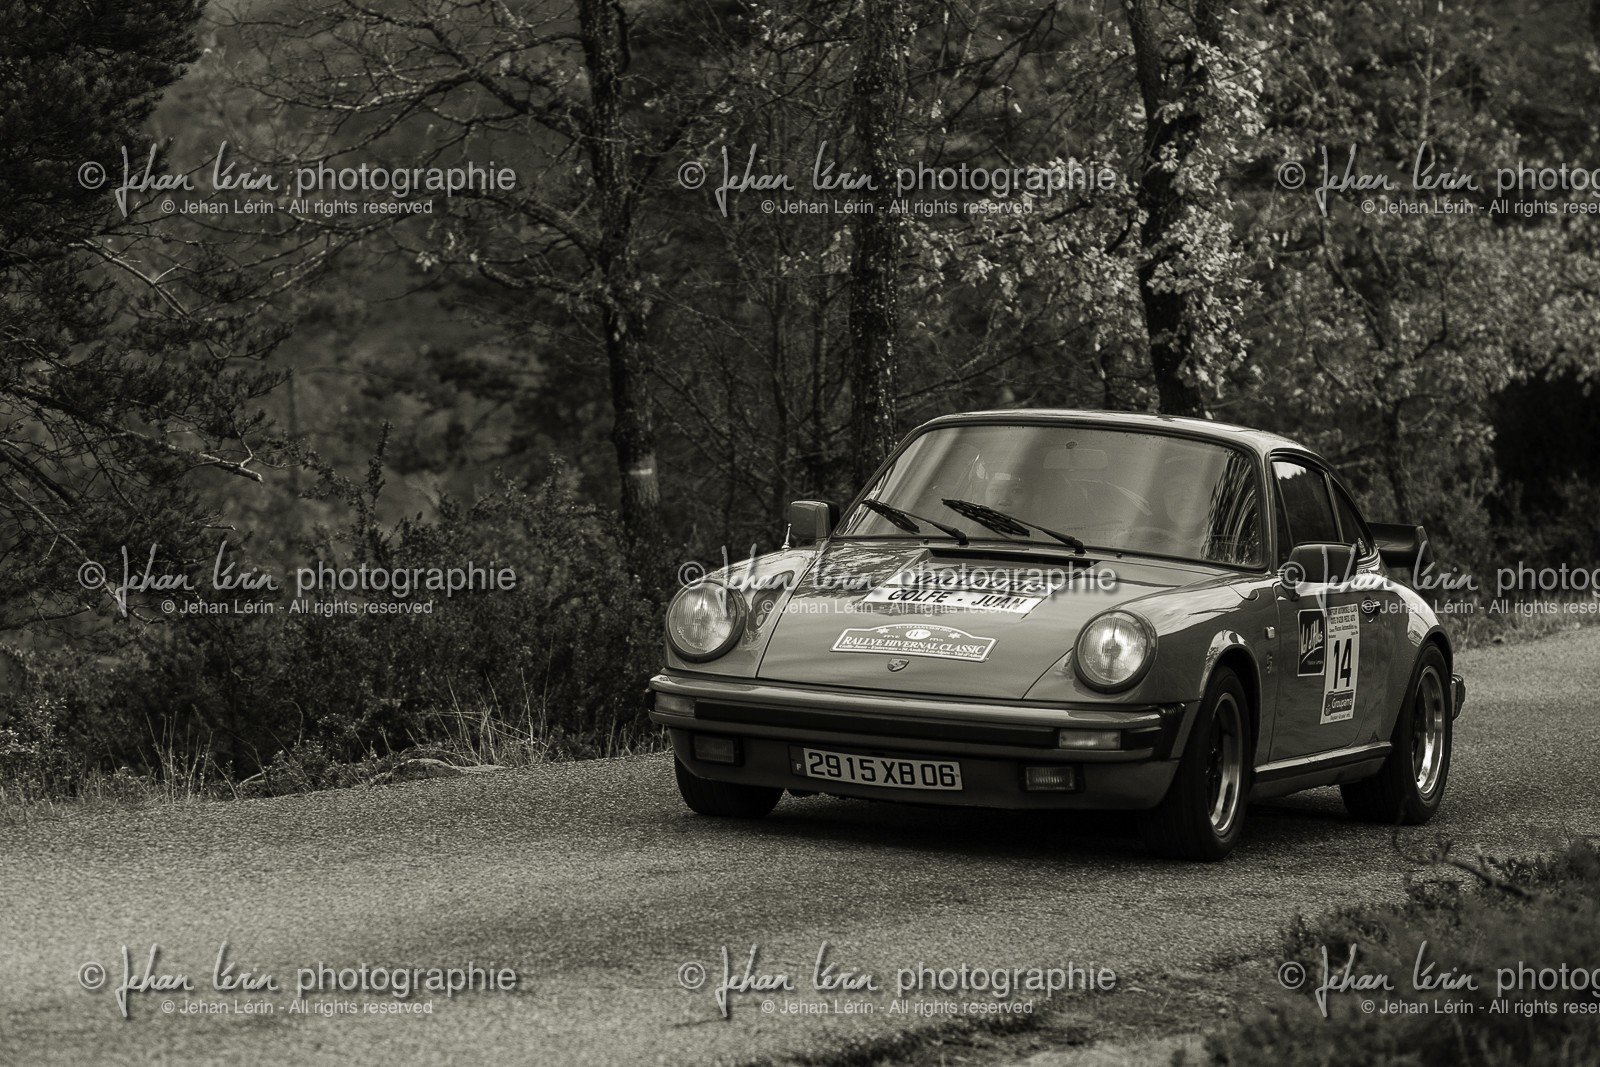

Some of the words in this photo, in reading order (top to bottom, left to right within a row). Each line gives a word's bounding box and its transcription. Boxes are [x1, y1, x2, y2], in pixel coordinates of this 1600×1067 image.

[888, 588, 953, 603] GOLFE
[971, 594, 1026, 610] JUAN
[842, 636, 886, 646] RALLYE
[884, 639, 939, 650] HIVERNAL
[939, 643, 986, 654] CLASSIC
[1333, 638, 1352, 689] 14
[809, 752, 876, 782] 2915
[881, 760, 915, 785] XB
[920, 763, 956, 787] 06
